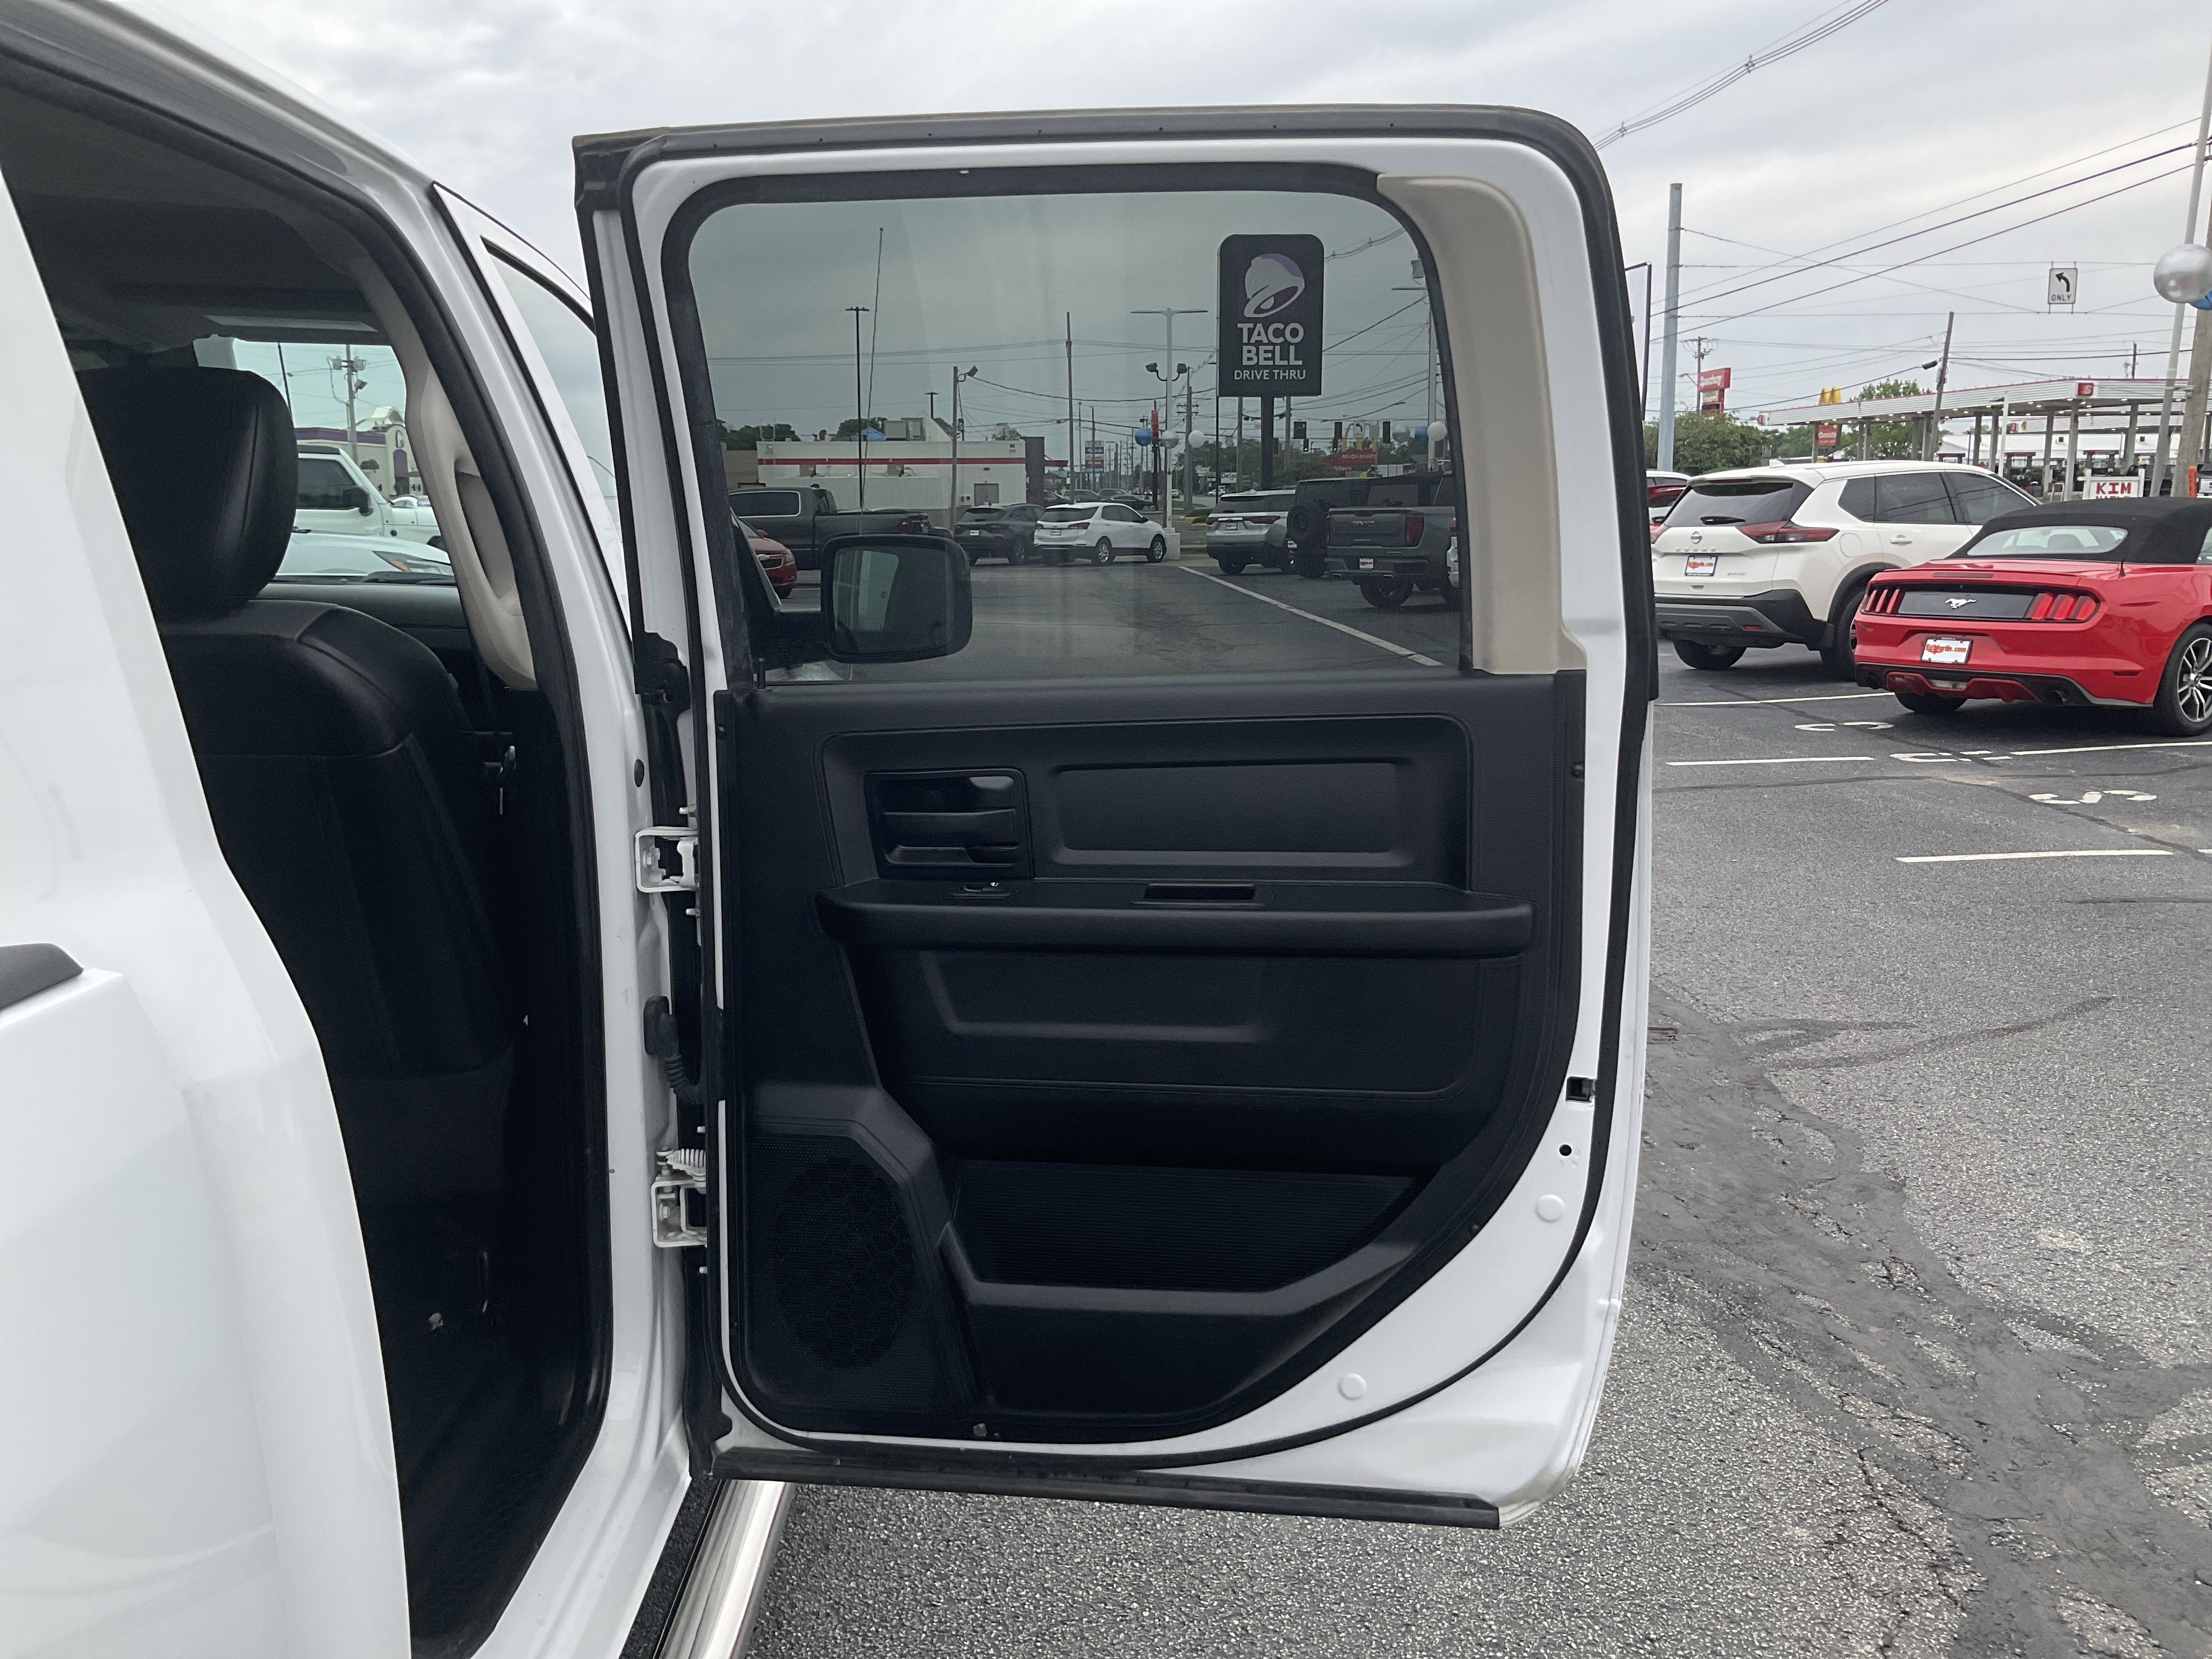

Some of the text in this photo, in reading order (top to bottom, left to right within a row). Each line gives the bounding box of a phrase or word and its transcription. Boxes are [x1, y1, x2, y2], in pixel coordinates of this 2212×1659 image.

[1237, 323, 1304, 343] TACO
[1242, 345, 1302, 365] BELL
[1234, 370, 1306, 380] DRIVE THRU
[2096, 482, 2131, 494] KIM
